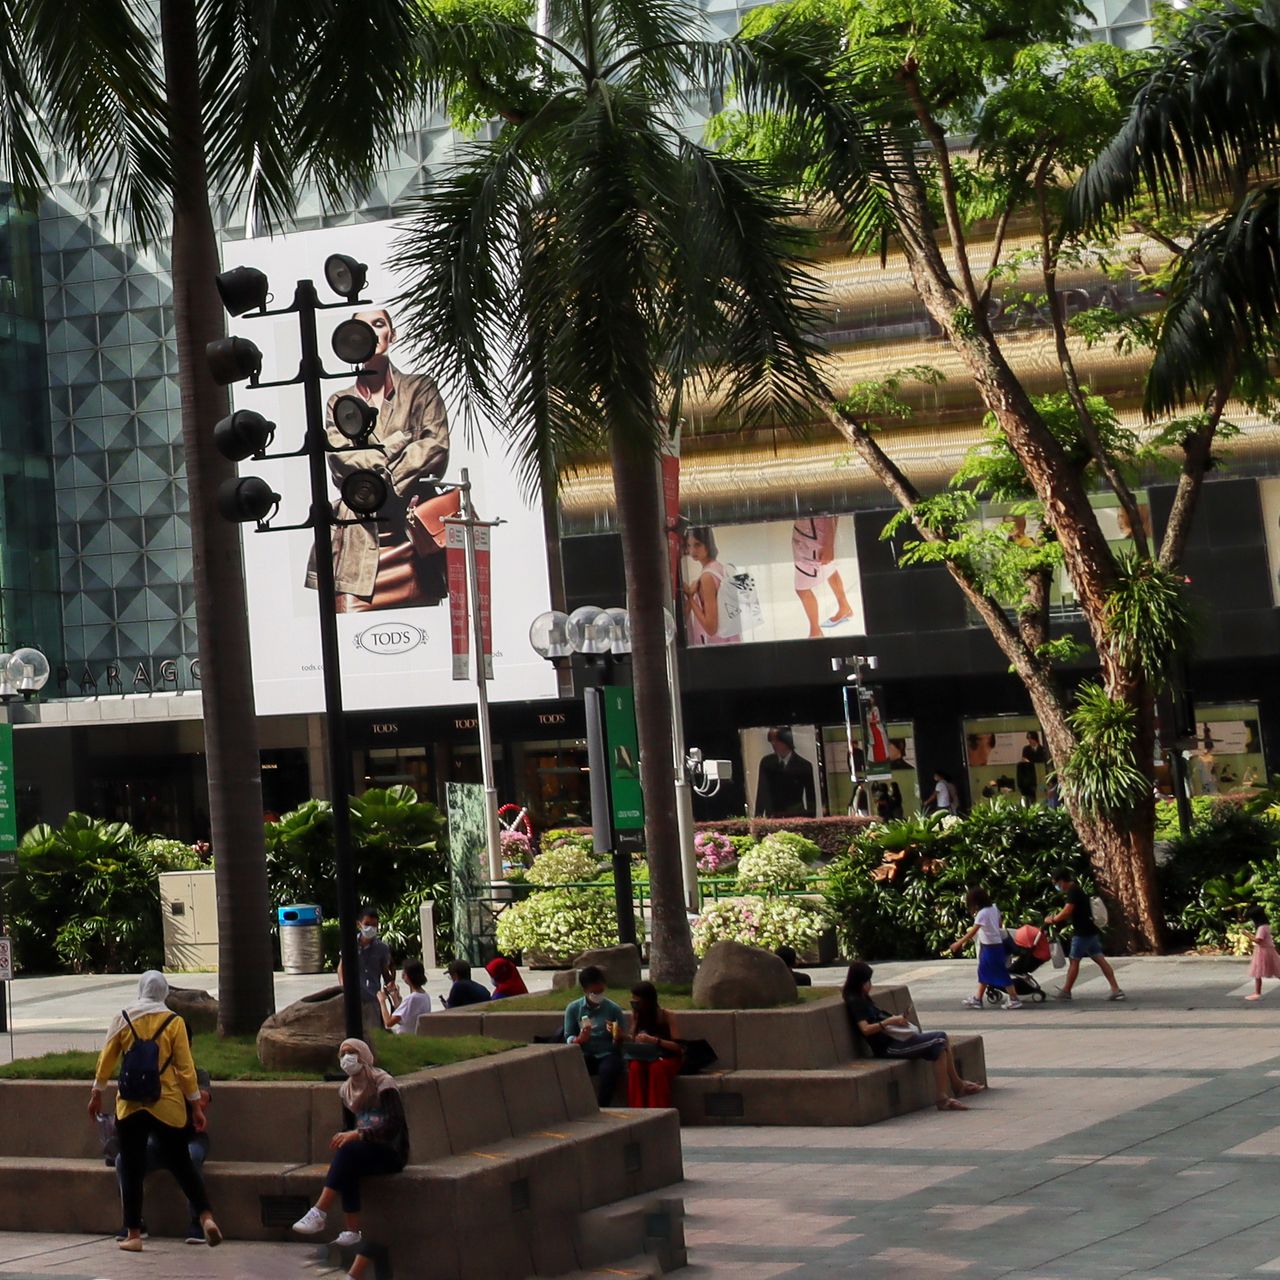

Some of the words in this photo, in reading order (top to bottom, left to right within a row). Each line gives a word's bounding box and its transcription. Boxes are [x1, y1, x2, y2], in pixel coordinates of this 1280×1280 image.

[371, 631, 411, 646] TOD'S
[538, 713, 566, 724] TOD'S
[372, 723, 398, 734] TOD'S
